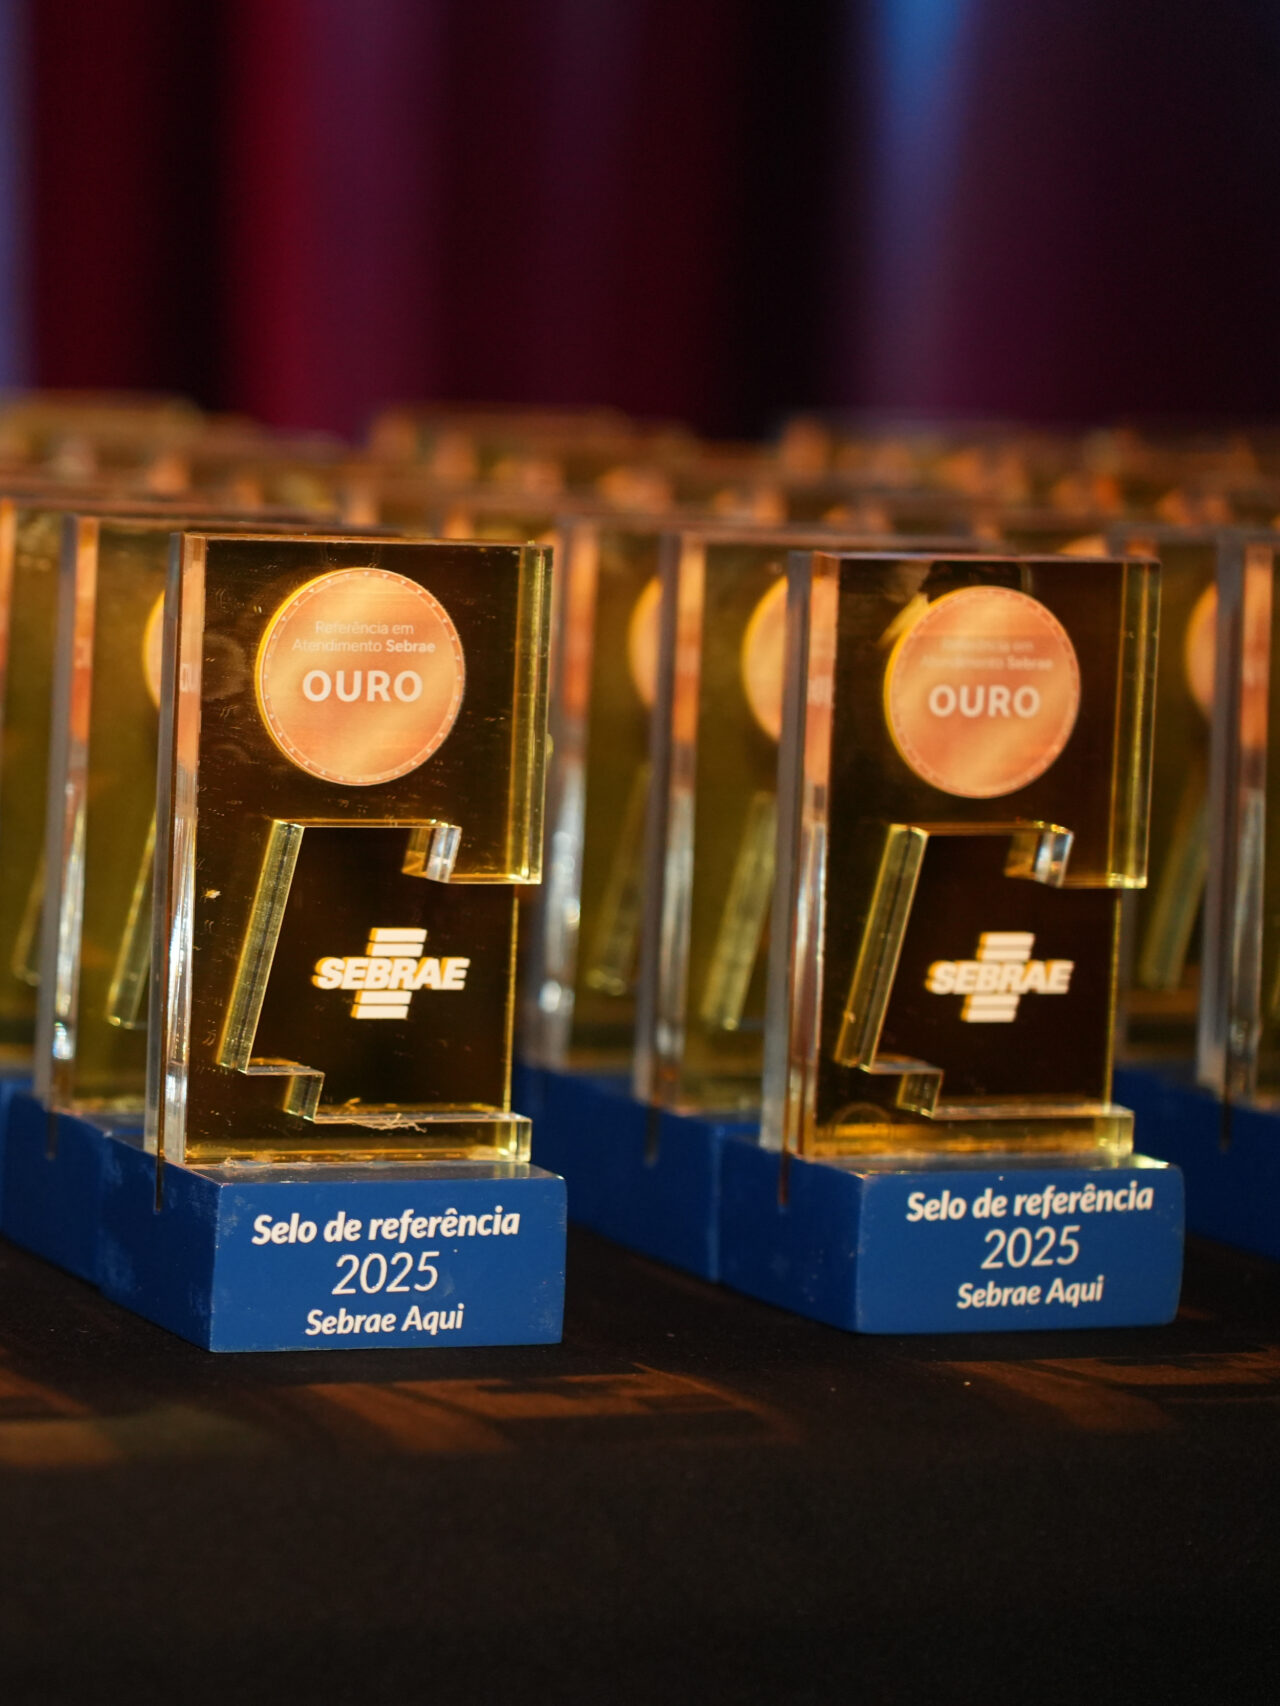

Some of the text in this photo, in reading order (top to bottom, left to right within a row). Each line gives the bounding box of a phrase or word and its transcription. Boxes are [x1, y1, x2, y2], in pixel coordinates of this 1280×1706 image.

[315, 620, 414, 635] Referência em
[292, 638, 436, 653] Atendimento Sebrae
[302, 670, 424, 703] OURO
[928, 684, 1041, 719] OURO
[312, 957, 470, 990] SEBRAE
[925, 959, 1074, 995] SEBRAE
[905, 1180, 1155, 1222] Selo de referência
[251, 1205, 521, 1245] Selo de referência
[980, 1225, 1081, 1270] 2025
[331, 1251, 440, 1295] 2025
[956, 1274, 1105, 1309] Sebrae Aqui
[305, 1303, 465, 1336] Sebrae Aqui
